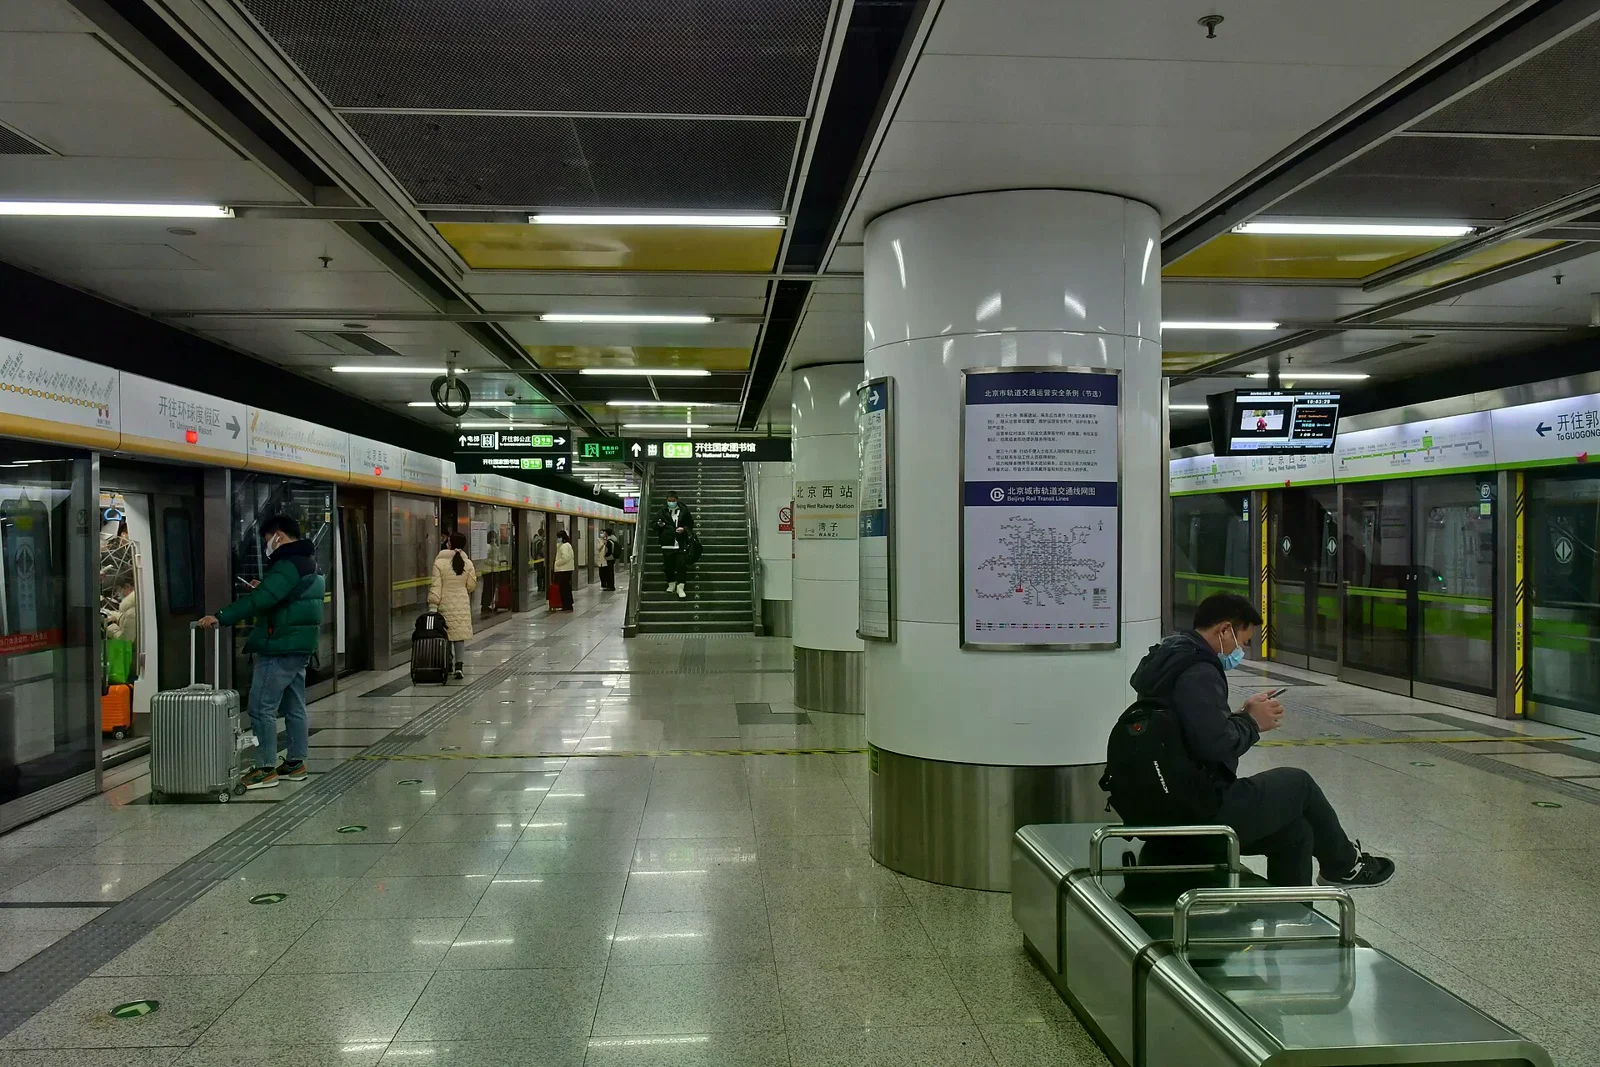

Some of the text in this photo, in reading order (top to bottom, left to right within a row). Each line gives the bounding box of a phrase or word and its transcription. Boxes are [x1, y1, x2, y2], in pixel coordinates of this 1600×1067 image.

[158, 395, 220, 427] 开往环球度假区
[169, 420, 175, 429] To
[1557, 410, 1600, 432] 开往郭
[1557, 433, 1565, 441] To
[695, 443, 756, 452] 开往国家图书馆
[797, 485, 853, 498] 北京西站
[1007, 486, 1096, 496] 北京城市轨道交通线网图
[818, 522, 838, 531] 湾子
